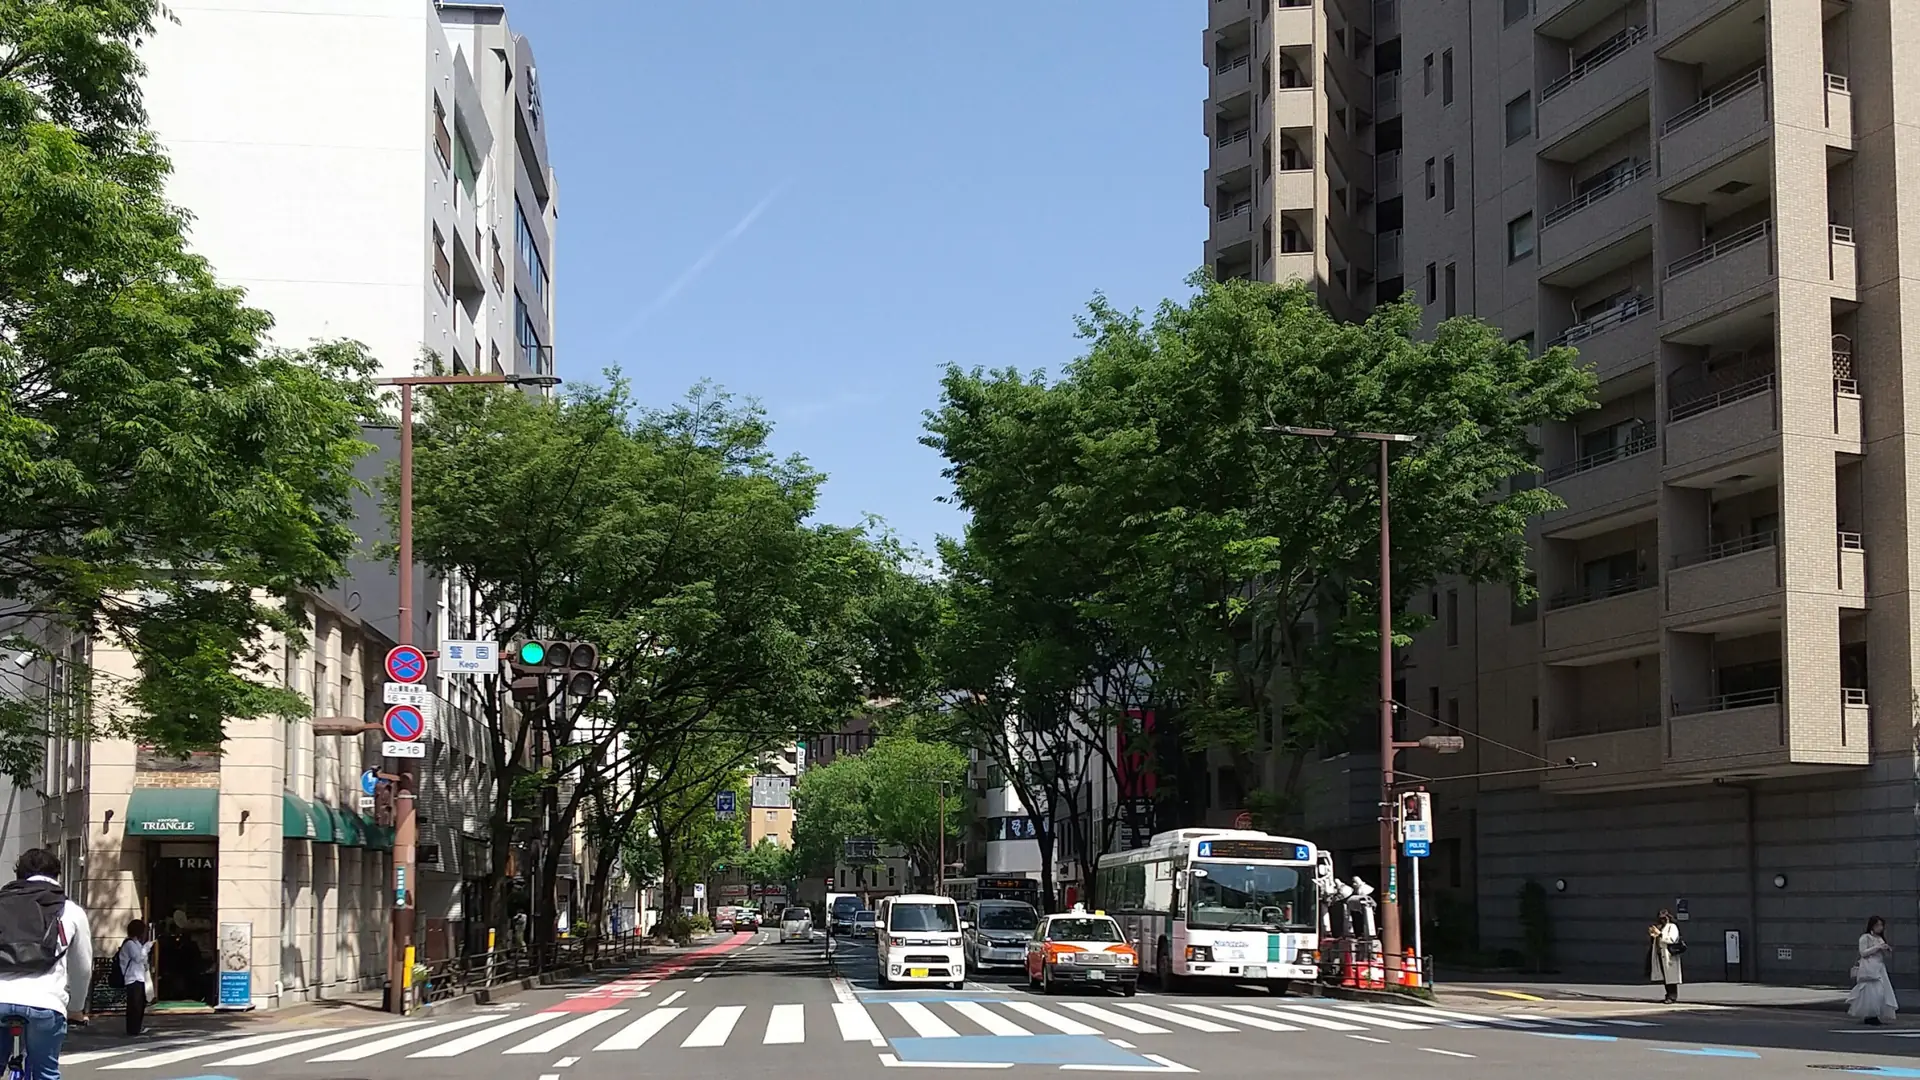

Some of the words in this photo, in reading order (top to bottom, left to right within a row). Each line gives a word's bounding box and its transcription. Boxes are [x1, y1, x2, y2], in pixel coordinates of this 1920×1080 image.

[459, 661, 479, 669] Kego
[388, 745, 420, 755] 2-16
[141, 821, 195, 830] TRIANGLE
[178, 858, 216, 868] TRIA
